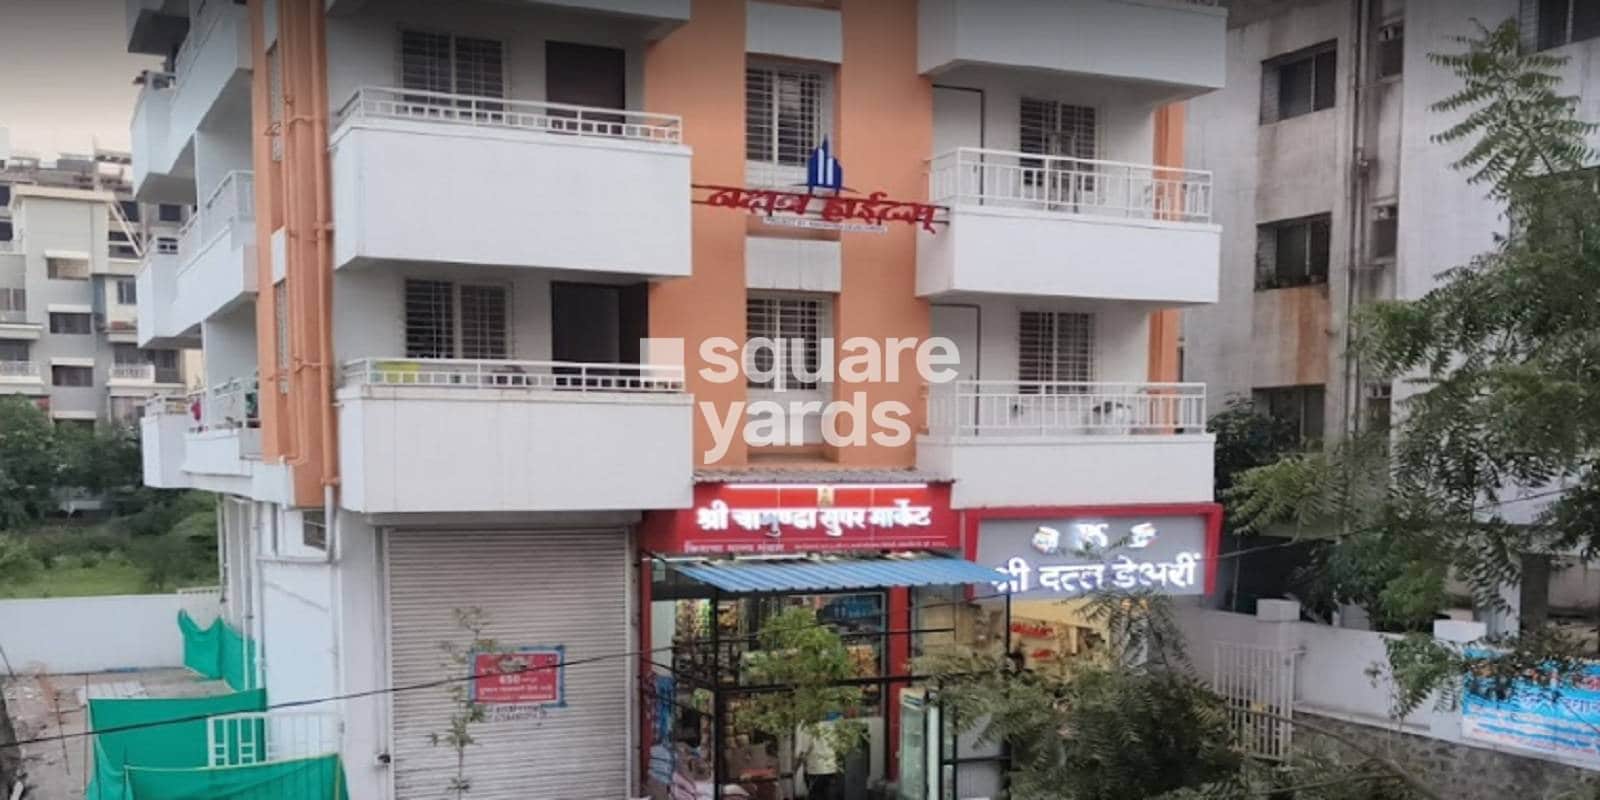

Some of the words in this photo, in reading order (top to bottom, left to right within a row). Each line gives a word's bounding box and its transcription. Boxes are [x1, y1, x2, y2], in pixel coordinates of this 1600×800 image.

[696, 499, 728, 531] श्री
[818, 506, 865, 537] सुपर
[868, 498, 932, 529] मार्केट
